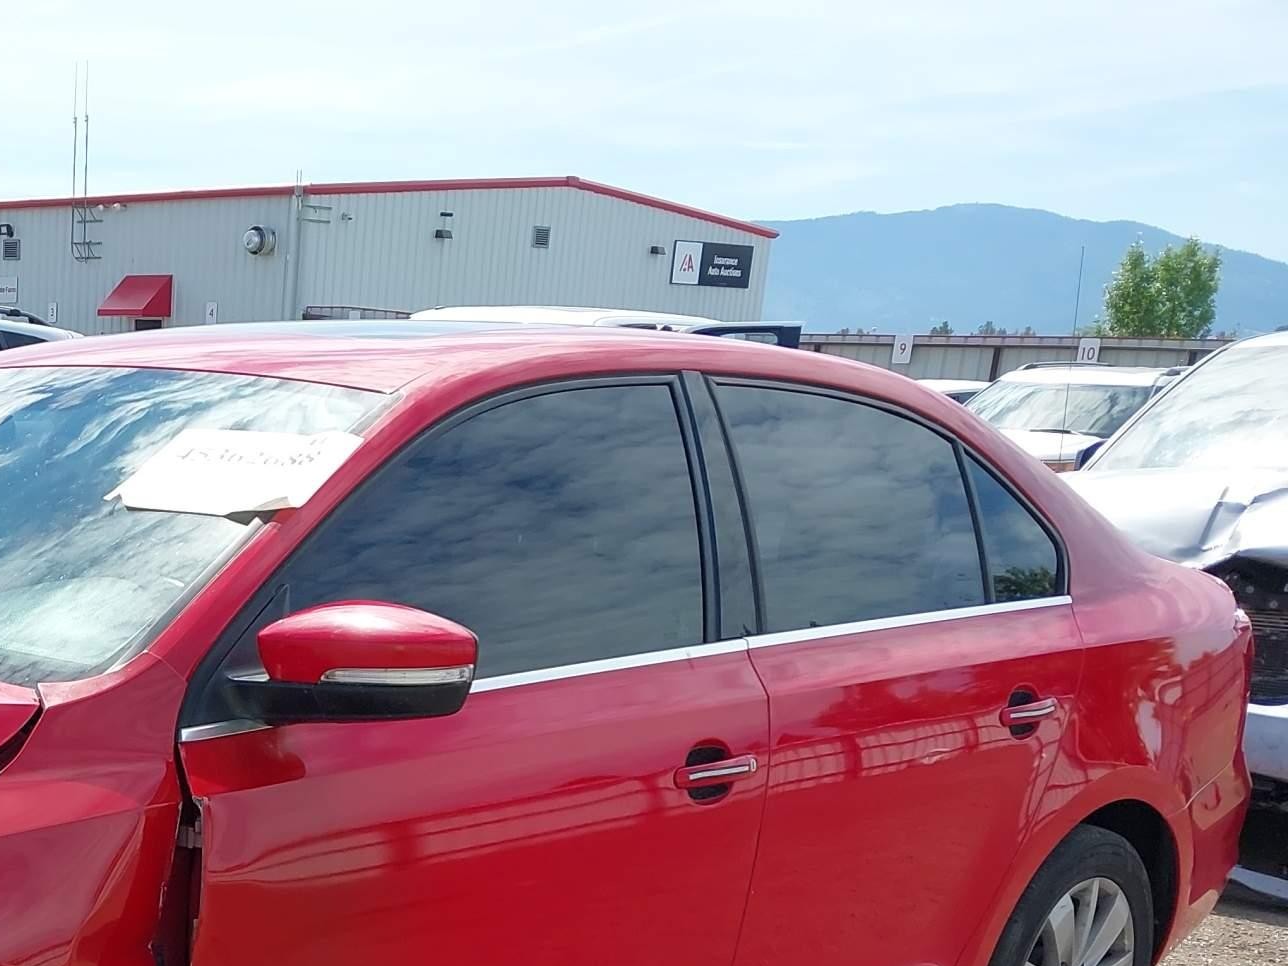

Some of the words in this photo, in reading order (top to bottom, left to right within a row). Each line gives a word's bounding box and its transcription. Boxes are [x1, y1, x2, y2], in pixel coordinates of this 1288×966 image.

[713, 255, 739, 266] Insurance
[707, 265, 720, 276] Auto
[720, 266, 742, 277] Auctions
[899, 342, 907, 356] 9
[1081, 346, 1096, 361] 10
